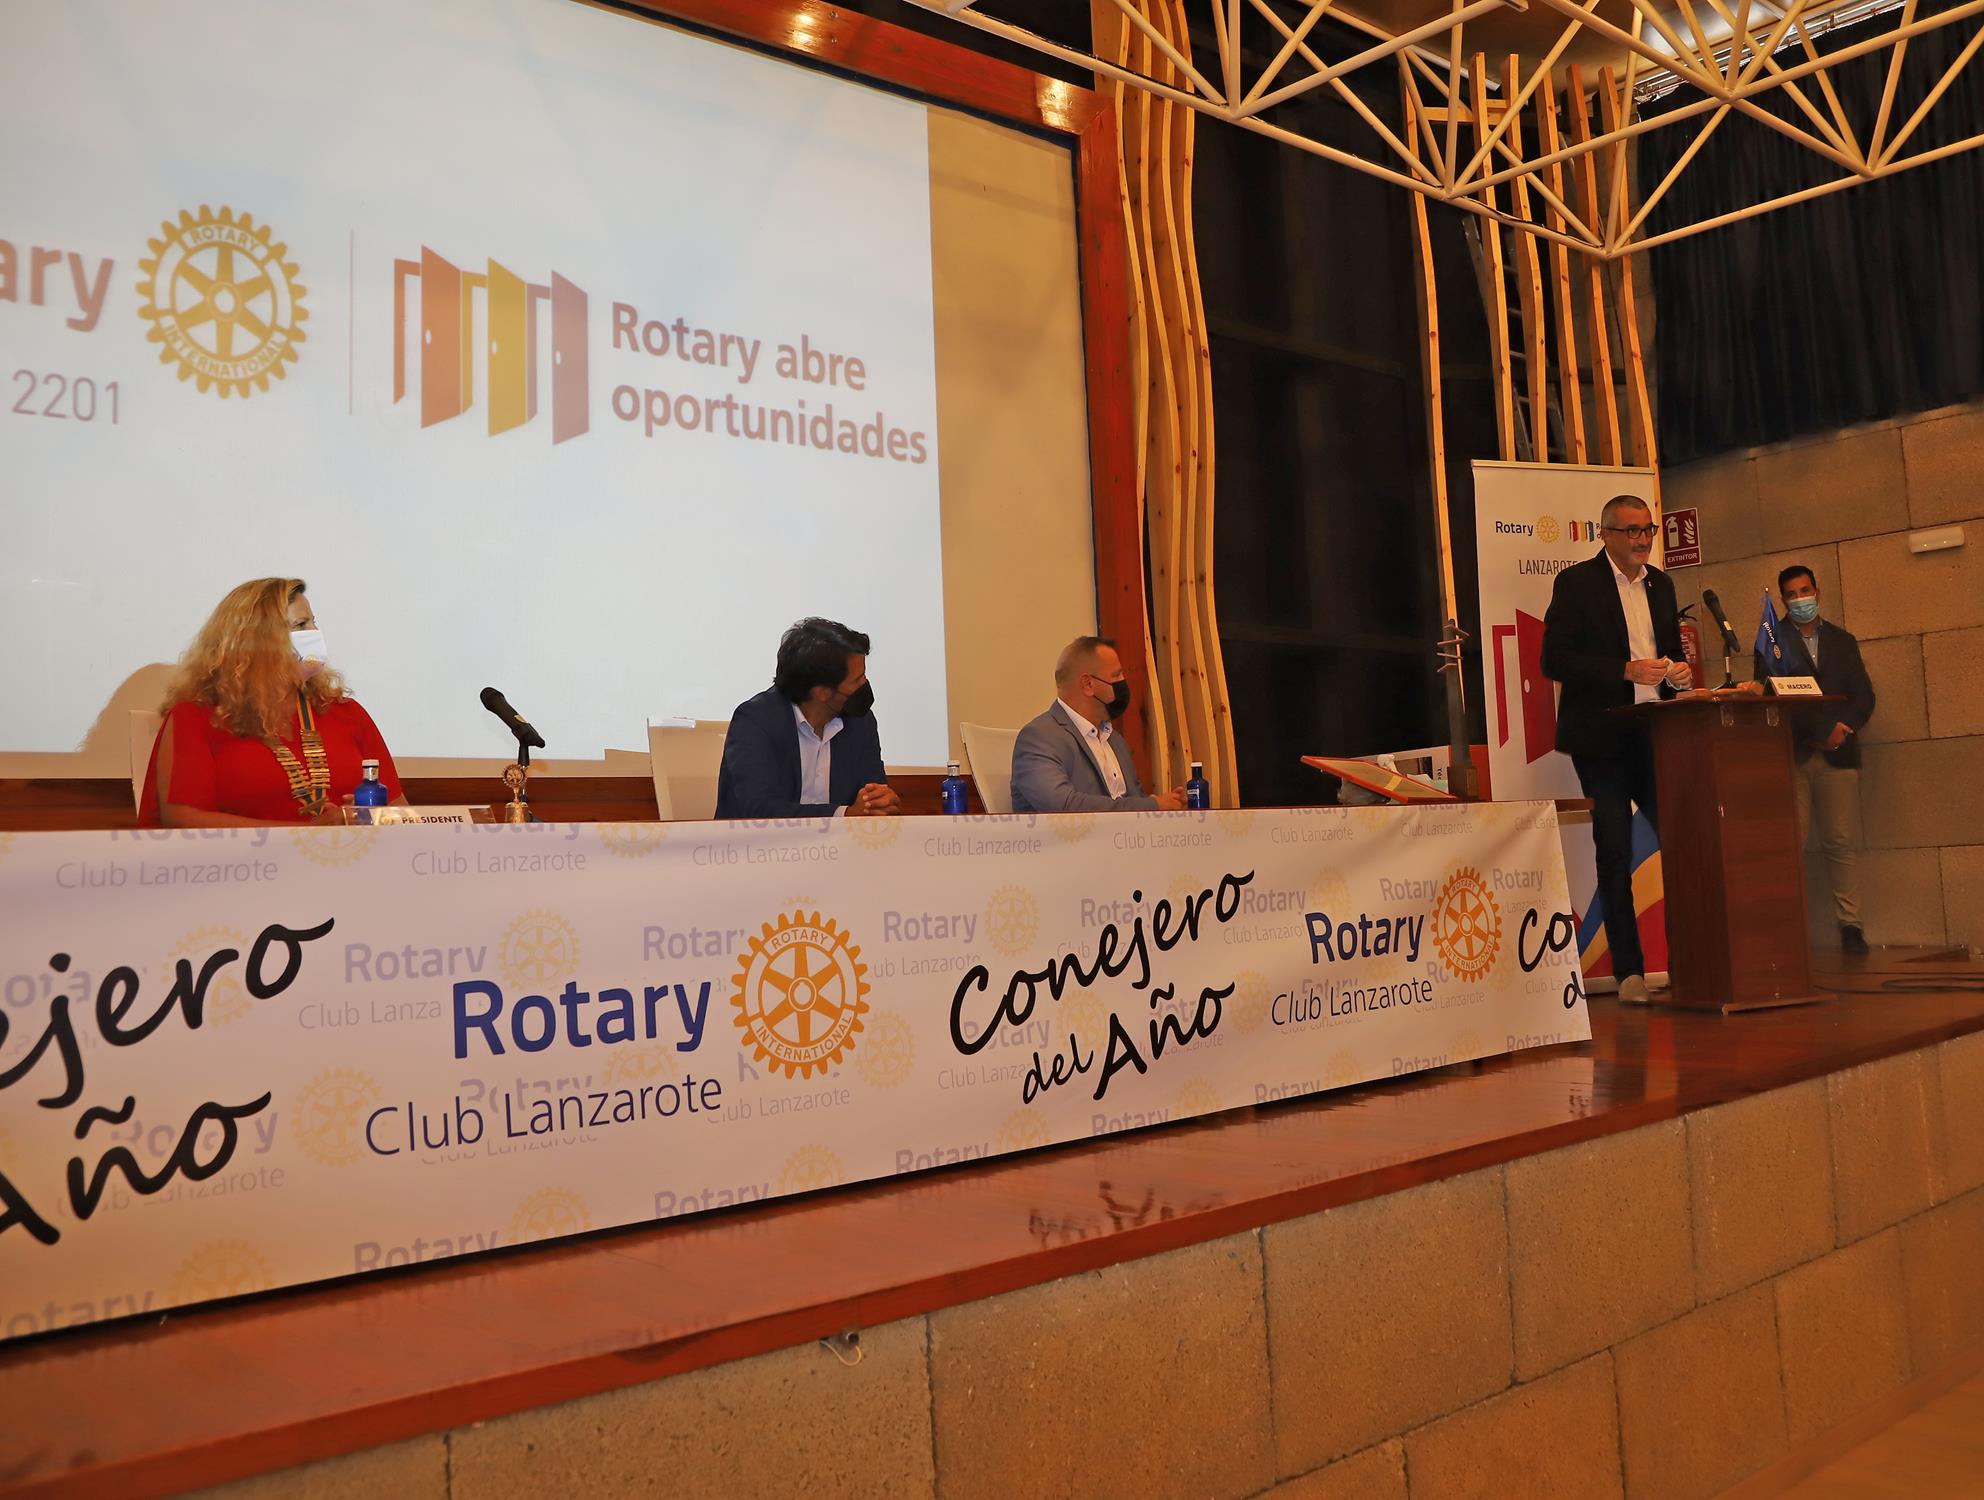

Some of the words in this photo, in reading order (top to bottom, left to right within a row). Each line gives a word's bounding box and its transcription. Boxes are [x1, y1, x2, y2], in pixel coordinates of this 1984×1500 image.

[189, 225, 261, 252] ROTARY
[163, 322, 284, 378] INTERNATIONAL
[612, 300, 761, 384] Rotary
[775, 333, 867, 391] abre
[12, 368, 120, 425] 2201
[611, 383, 928, 465] oportunidades
[1495, 520, 1534, 536] Rotary
[1667, 552, 1698, 563] EXTINTOR
[402, 815, 464, 824] PRESIDENTE
[924, 838, 962, 857] Club
[1114, 832, 1146, 850] Club
[1271, 827, 1298, 843] Club
[411, 851, 468, 876] Club
[692, 843, 738, 866] Club
[56, 861, 128, 889] Club
[1451, 880, 1477, 894] ROTARY
[1492, 867, 1544, 892] Rotary
[1243, 888, 1306, 916] Rotary
[1380, 877, 1438, 902] Rotary
[771, 929, 829, 951] ROTARY
[883, 911, 978, 944] Rotary
[1256, 923, 1305, 943] Lanzaro
[1304, 911, 1424, 964] Rotary
[949, 869, 1255, 1056] Conejero
[1445, 939, 1495, 971] INTERNATIONAL
[298, 1000, 361, 1030] Club
[371, 1000, 442, 1024] Lanza
[1271, 987, 1322, 1026] Club
[1330, 977, 1433, 1017] Lanzarote
[452, 979, 712, 1060] Rotary
[755, 1013, 853, 1062] INTERNATIONAL
[1023, 1033, 1093, 1104] del
[1093, 981, 1236, 1101] Año
[365, 1095, 485, 1156] Club
[505, 1073, 723, 1139] Lanzarote
[760, 1086, 851, 1116] Lanzarote
